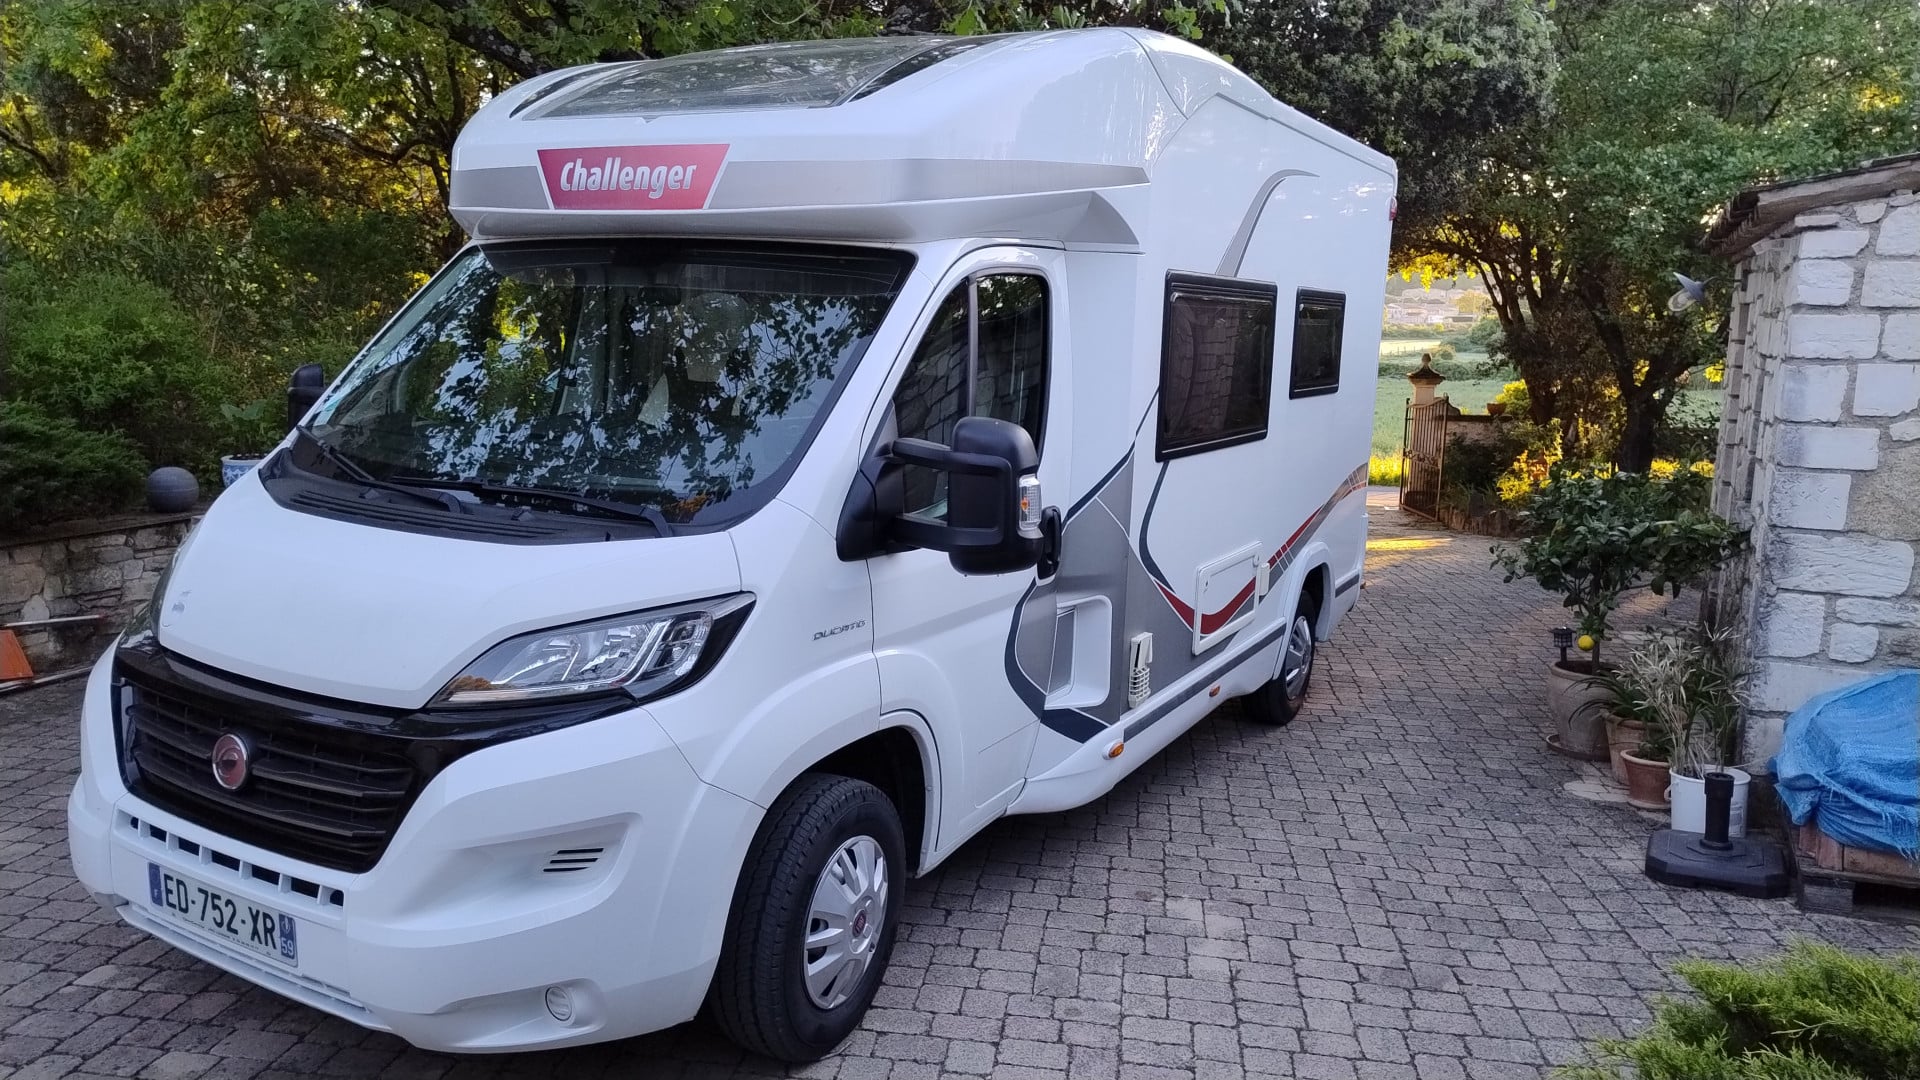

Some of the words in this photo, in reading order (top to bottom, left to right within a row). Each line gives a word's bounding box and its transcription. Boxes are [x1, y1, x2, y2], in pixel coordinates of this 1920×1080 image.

[560, 157, 697, 199] Challenger
[813, 619, 866, 641] DUCATO
[163, 873, 277, 950] ED-752-XR
[280, 937, 294, 956] 59
